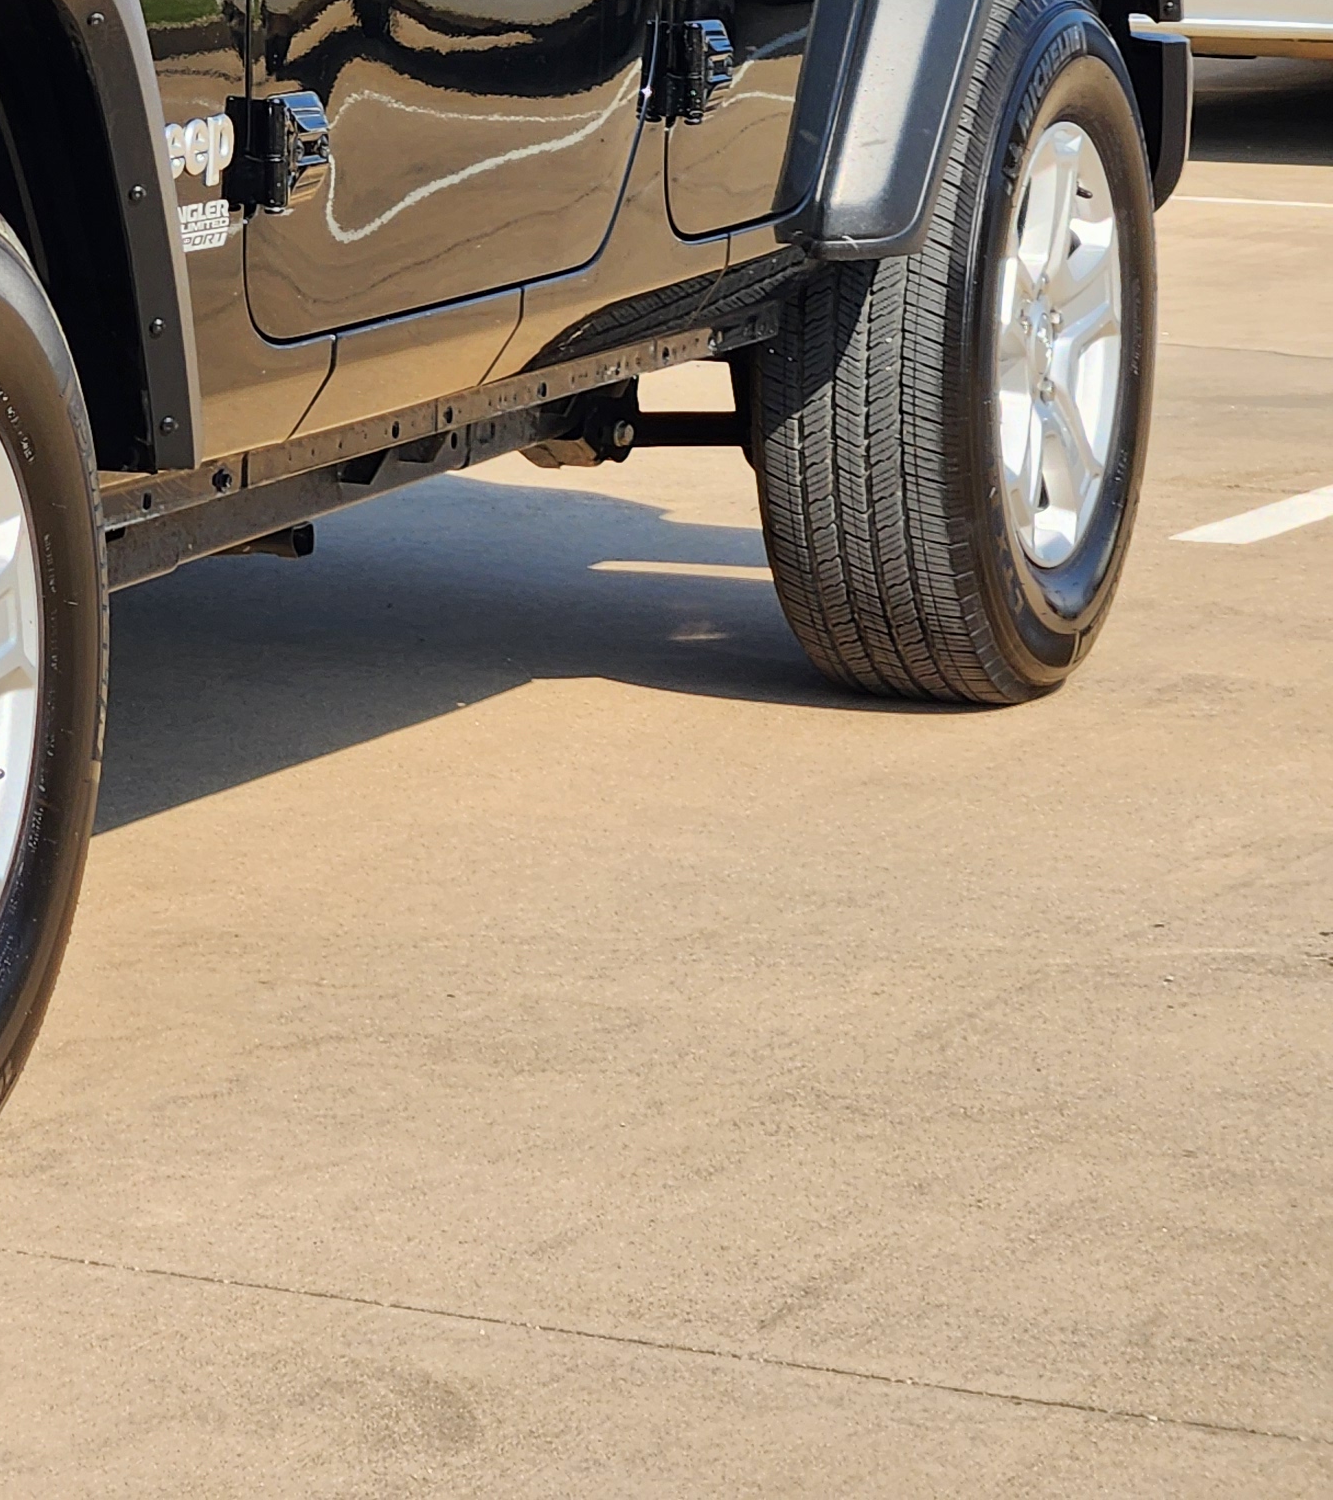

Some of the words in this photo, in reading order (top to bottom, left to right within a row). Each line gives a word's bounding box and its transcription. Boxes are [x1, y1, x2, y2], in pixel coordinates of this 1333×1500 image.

[165, 113, 234, 187] eep
[181, 217, 229, 233] LIMITED
[182, 233, 227, 247] PORT
